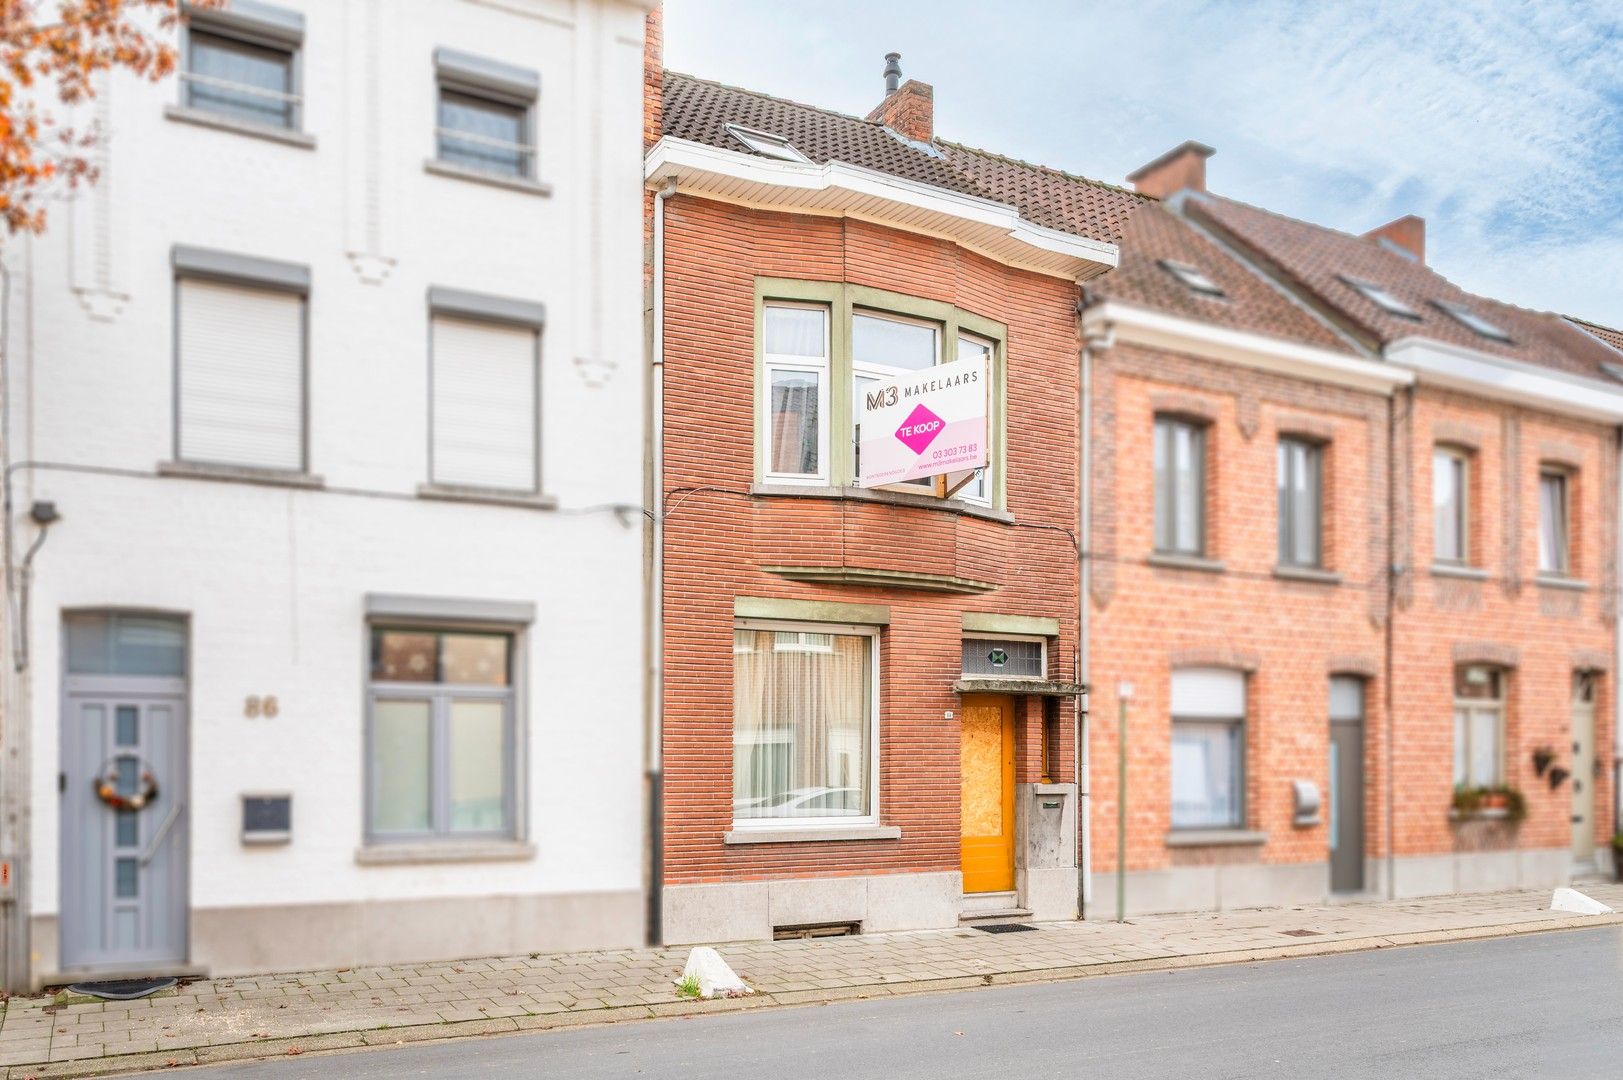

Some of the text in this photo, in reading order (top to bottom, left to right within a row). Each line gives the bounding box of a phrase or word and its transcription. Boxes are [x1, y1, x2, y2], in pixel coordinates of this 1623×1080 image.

[866, 371, 978, 411] M3 MAKELAARS
[900, 421, 940, 438] TE KOOP
[932, 450, 942, 460] 03
[943, 448, 957, 458] 303
[958, 445, 967, 454] 73
[244, 694, 279, 720] 86
